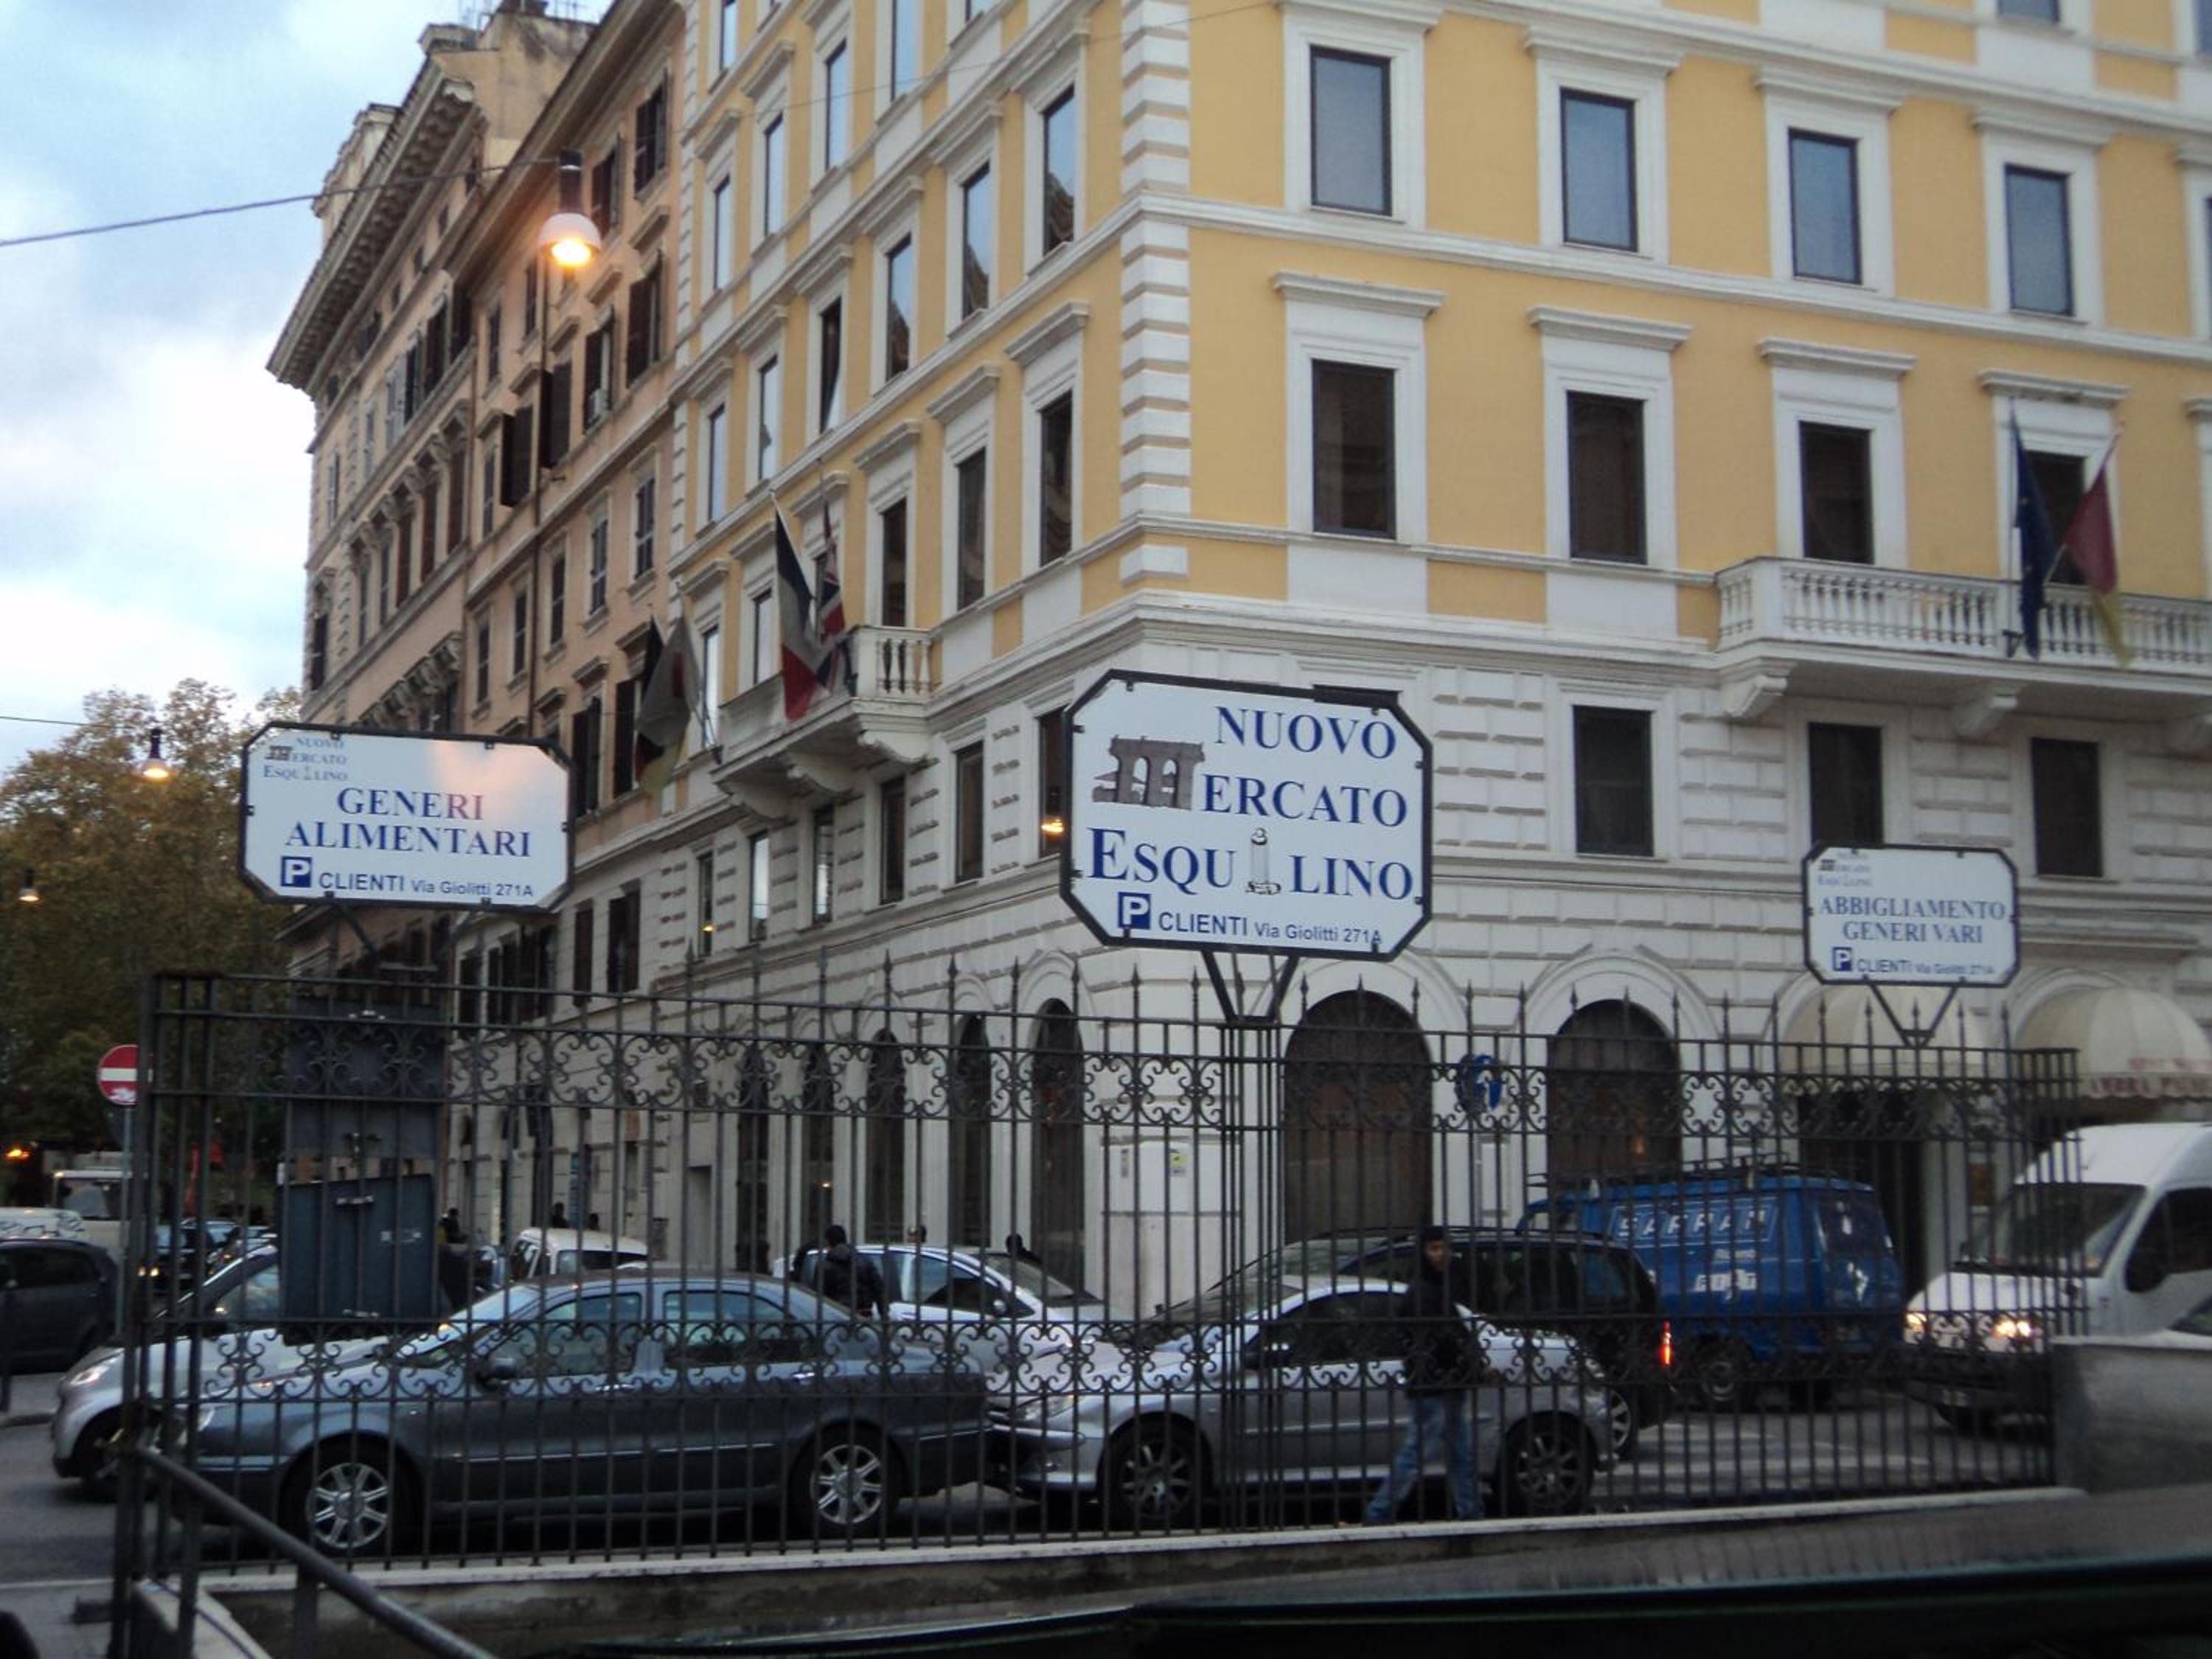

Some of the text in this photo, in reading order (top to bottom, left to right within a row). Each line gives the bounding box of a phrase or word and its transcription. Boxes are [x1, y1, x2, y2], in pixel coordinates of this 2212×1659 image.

[1214, 706, 1397, 759] NUOVO
[338, 786, 484, 821] GENERI
[285, 821, 531, 858] ALIMENTARI
[319, 872, 404, 891] CLIENTI
[411, 879, 434, 894] Via
[440, 881, 490, 896] Giolitti
[495, 884, 534, 897] 271A
[1819, 895, 2006, 920] ABBIGLIAMENTO
[1158, 911, 1248, 936] CLIENTI
[1253, 922, 1280, 939] Via
[1285, 923, 1338, 942] Giolitti
[1343, 928, 1382, 944] 271A
[1843, 922, 1983, 944] GENERI VARI
[1857, 958, 1912, 973] CLIENTI
